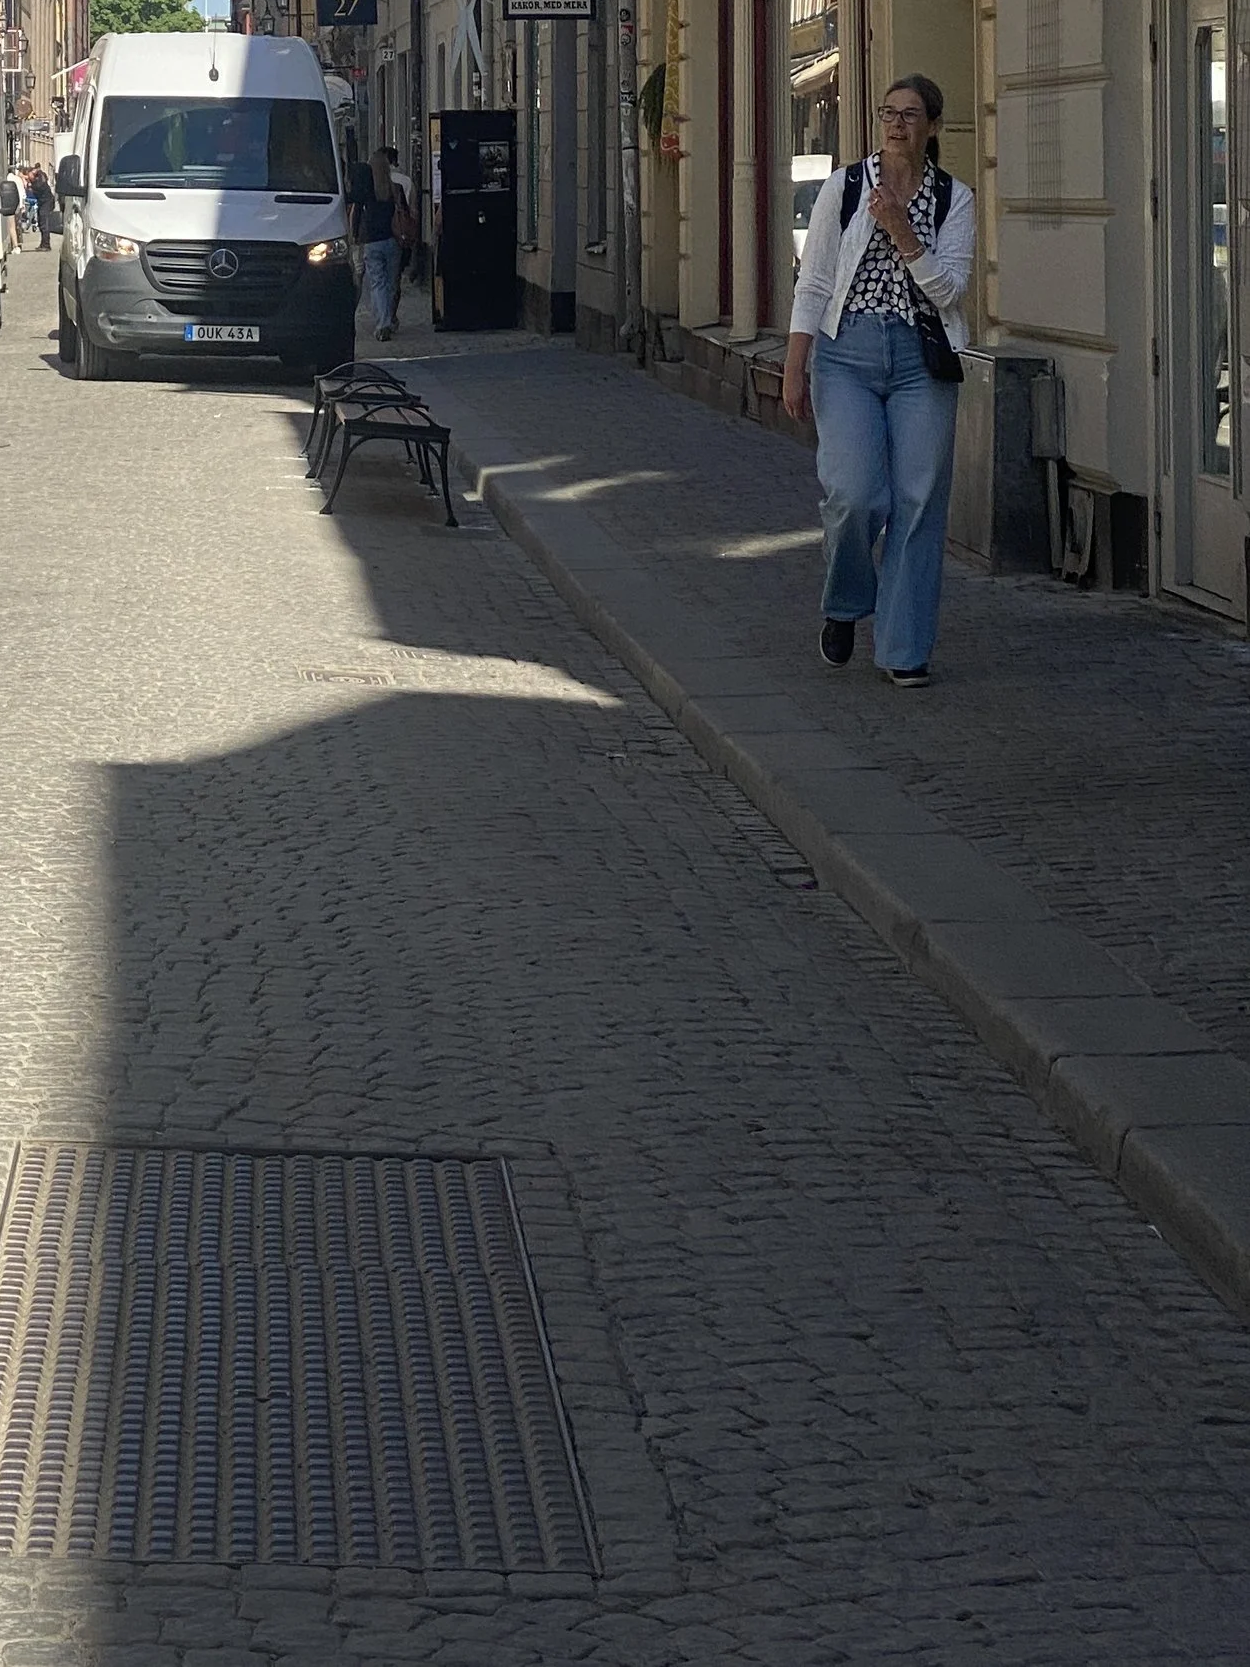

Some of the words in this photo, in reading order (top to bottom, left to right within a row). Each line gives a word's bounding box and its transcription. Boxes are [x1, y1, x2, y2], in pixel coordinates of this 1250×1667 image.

[543, 1, 562, 9] MED
[383, 50, 394, 60] 27
[197, 326, 223, 339] OUK
[227, 327, 254, 340] 43A
